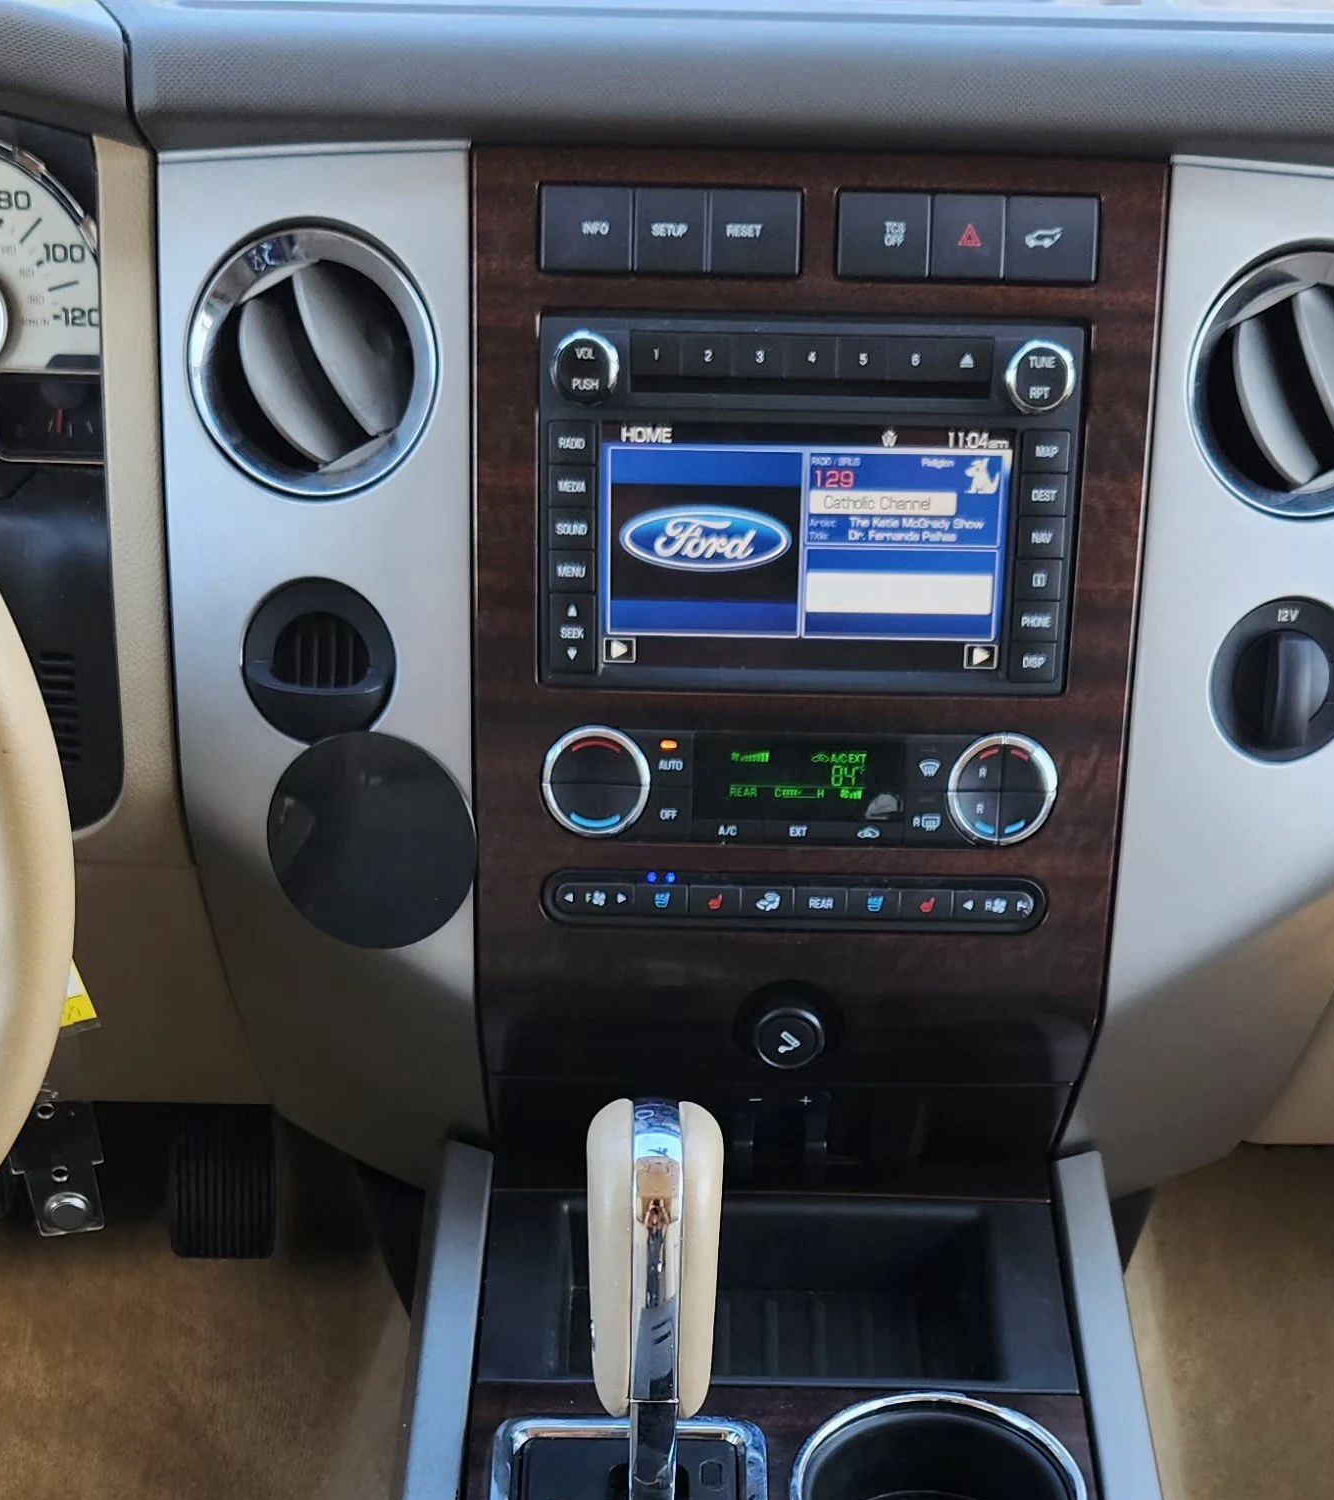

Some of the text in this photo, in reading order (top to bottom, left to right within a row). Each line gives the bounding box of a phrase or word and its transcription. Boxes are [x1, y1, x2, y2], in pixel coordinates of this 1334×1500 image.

[581, 221, 610, 236] INFO
[651, 223, 689, 237] SETUP
[726, 224, 763, 238] RESET
[43, 243, 85, 264] 100
[61, 307, 100, 327] 120
[575, 347, 595, 360] VOL
[653, 348, 659, 361] 1
[703, 349, 713, 362] 2
[754, 351, 764, 363] 3
[807, 351, 817, 363] 4
[858, 352, 868, 366] 5
[1028, 355, 1056, 369] TUNE
[571, 377, 599, 391] PUSH
[1028, 385, 1051, 399] RPT
[620, 427, 673, 444] HOME
[557, 437, 585, 449] RADIO
[1035, 443, 1059, 458] MAP
[814, 469, 855, 488] 129
[557, 479, 586, 493] MEDIA
[1031, 487, 1058, 502] DEST
[823, 495, 932, 511] Catholic Channel
[555, 522, 588, 536] SOUND
[848, 517, 870, 528] The
[953, 518, 985, 530] Show
[653, 517, 757, 560] Ford
[1031, 530, 1054, 544] NAV
[556, 565, 586, 578] MENU
[1020, 612, 1053, 628] PHONE
[1277, 608, 1301, 622] 12V
[560, 626, 584, 639] SEEK
[1022, 654, 1046, 669] DISP
[658, 759, 684, 772] AUTO
[830, 753, 867, 764] A/C EXT
[978, 766, 987, 778] R
[729, 787, 758, 797] REAR
[659, 808, 678, 821] OFF
[976, 803, 984, 815] R
[718, 824, 737, 838] A/C
[789, 825, 808, 837] EXT
[808, 895, 834, 910] REAR
